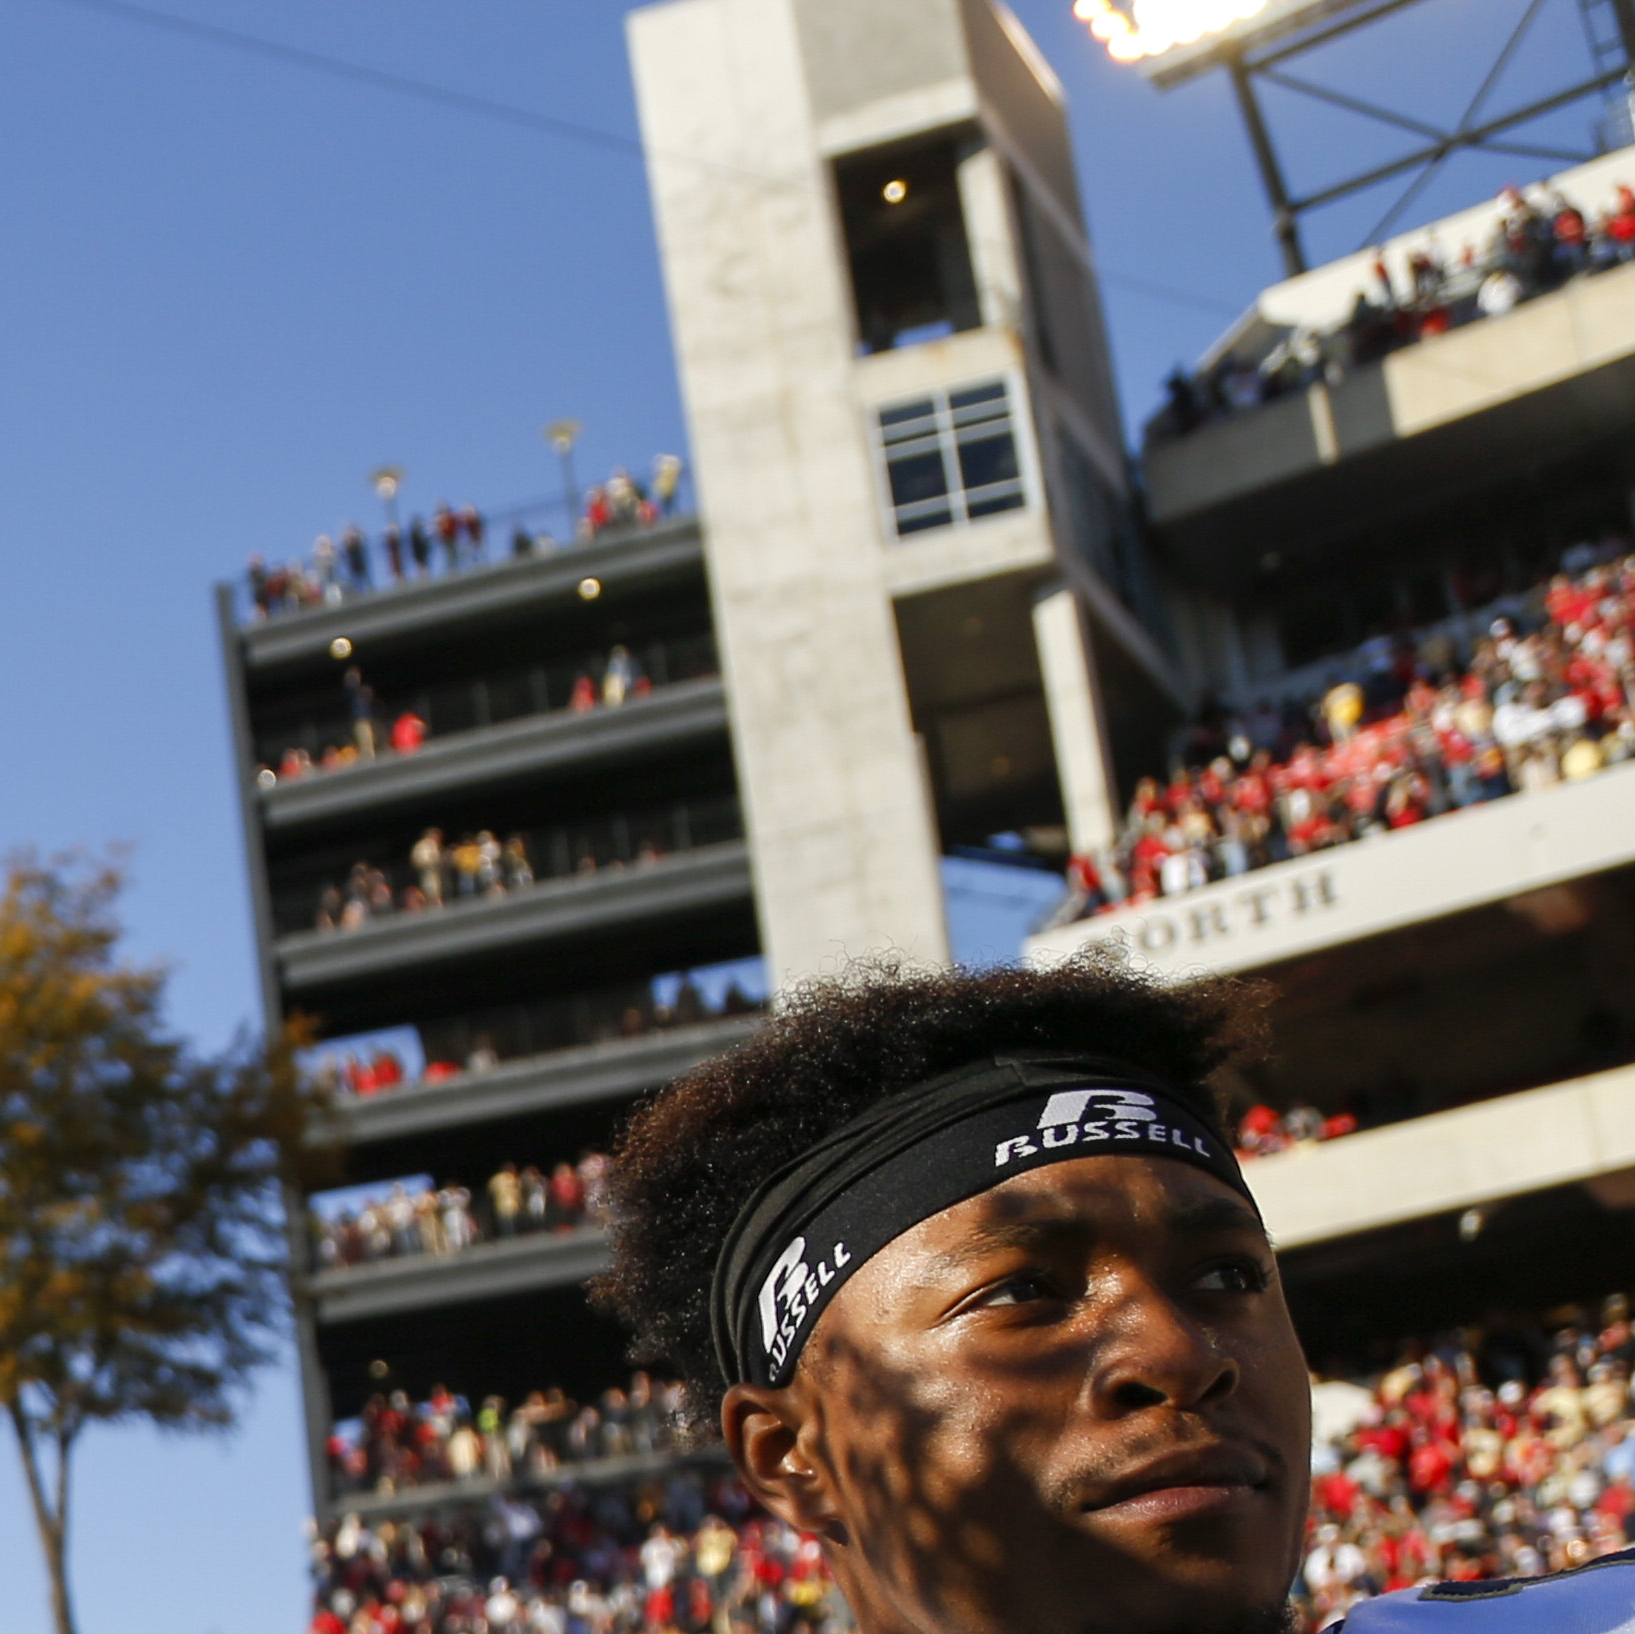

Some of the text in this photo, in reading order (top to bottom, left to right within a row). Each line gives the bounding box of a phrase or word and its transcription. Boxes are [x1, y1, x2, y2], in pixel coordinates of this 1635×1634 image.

[1121, 866, 1339, 957] ORTH
[994, 1121, 1211, 1168] RUSSELL
[768, 1242, 852, 1382] RUSSELL
